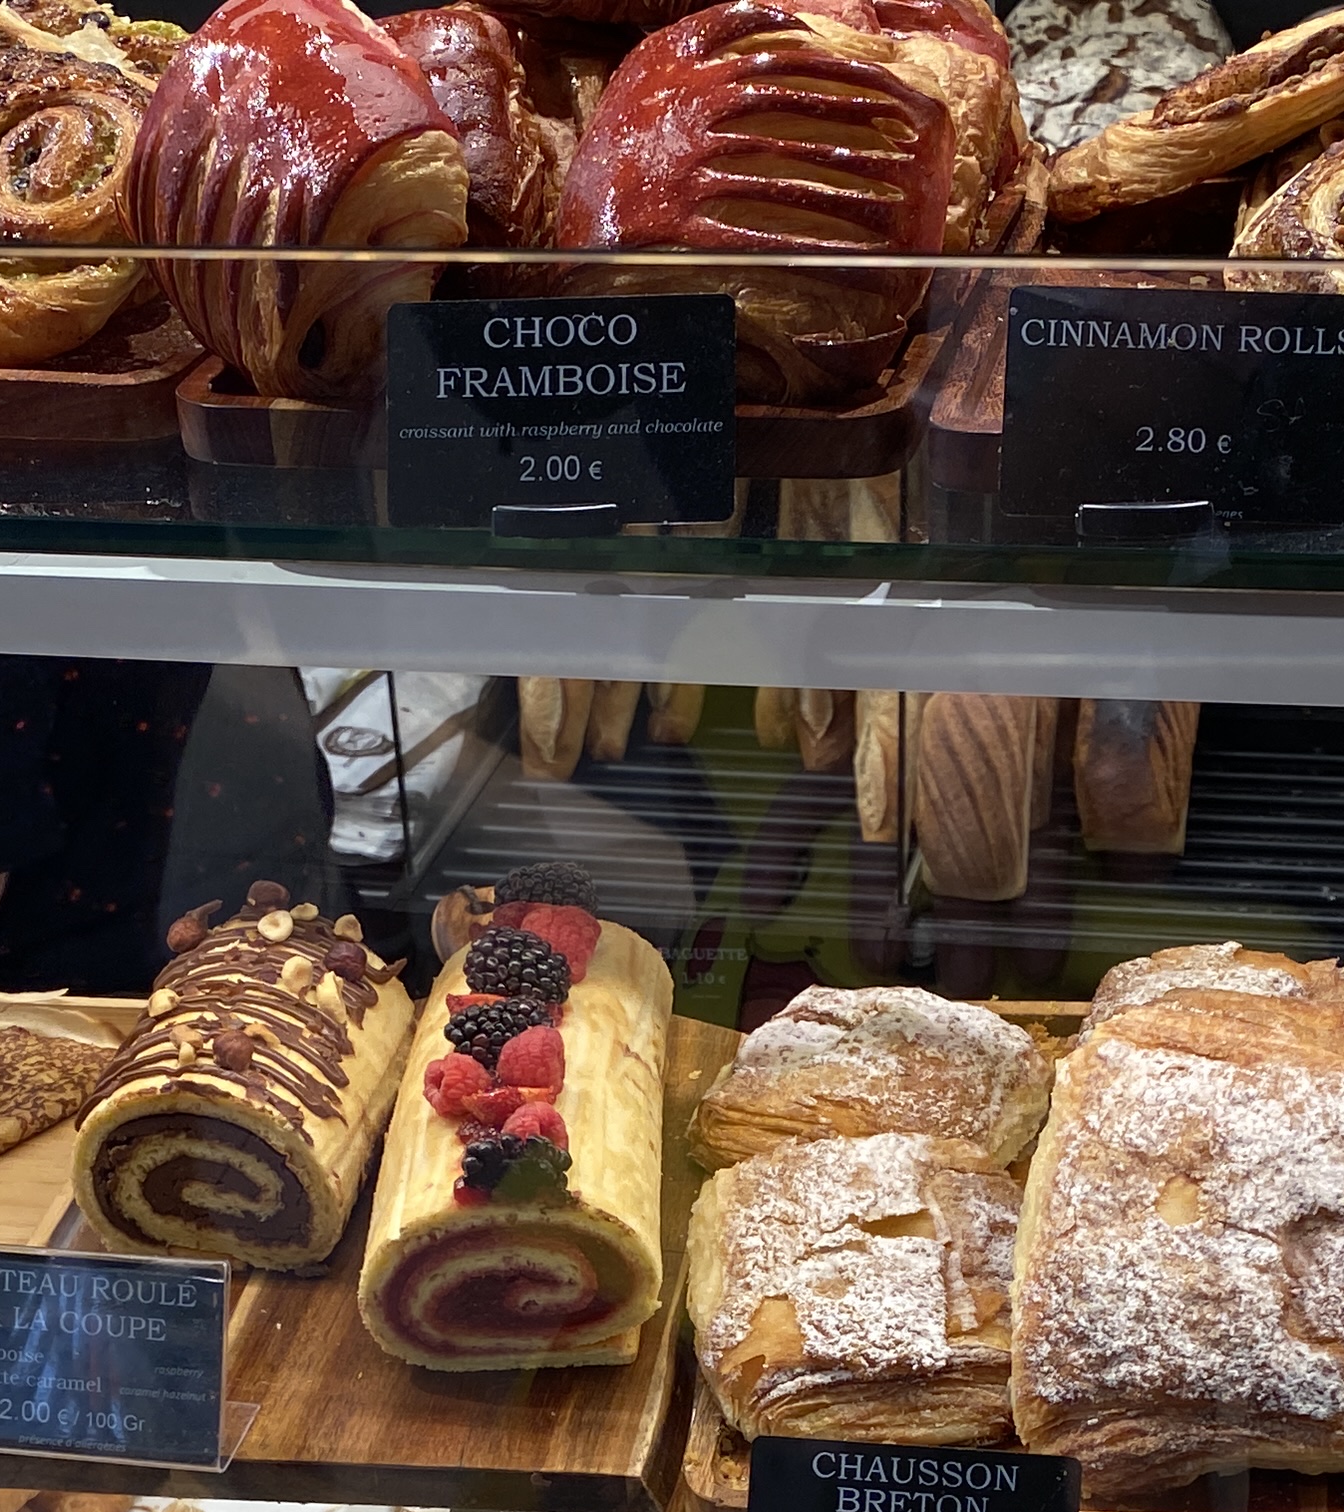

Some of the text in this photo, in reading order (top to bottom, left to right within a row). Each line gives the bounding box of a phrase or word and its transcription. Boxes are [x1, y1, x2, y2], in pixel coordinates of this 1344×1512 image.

[483, 314, 637, 348] CHOCO
[1020, 318, 1225, 351] CINNAMON
[436, 362, 687, 398] FRAMBOISE
[399, 418, 723, 440] croissant with raspberry and chocolate
[1135, 427, 1232, 453] 2.80 €
[519, 455, 603, 481] 2.00 €
[91, 1276, 197, 1308] ROULÉ
[14, 1306, 48, 1331] LA
[60, 1312, 166, 1342] COUPE
[26, 1373, 101, 1393] caramel
[0, 1399, 51, 1423] 2.00
[87, 1411, 117, 1429] 100
[123, 1414, 145, 1432] Gr
[812, 1451, 1020, 1491] CHAUSSON
